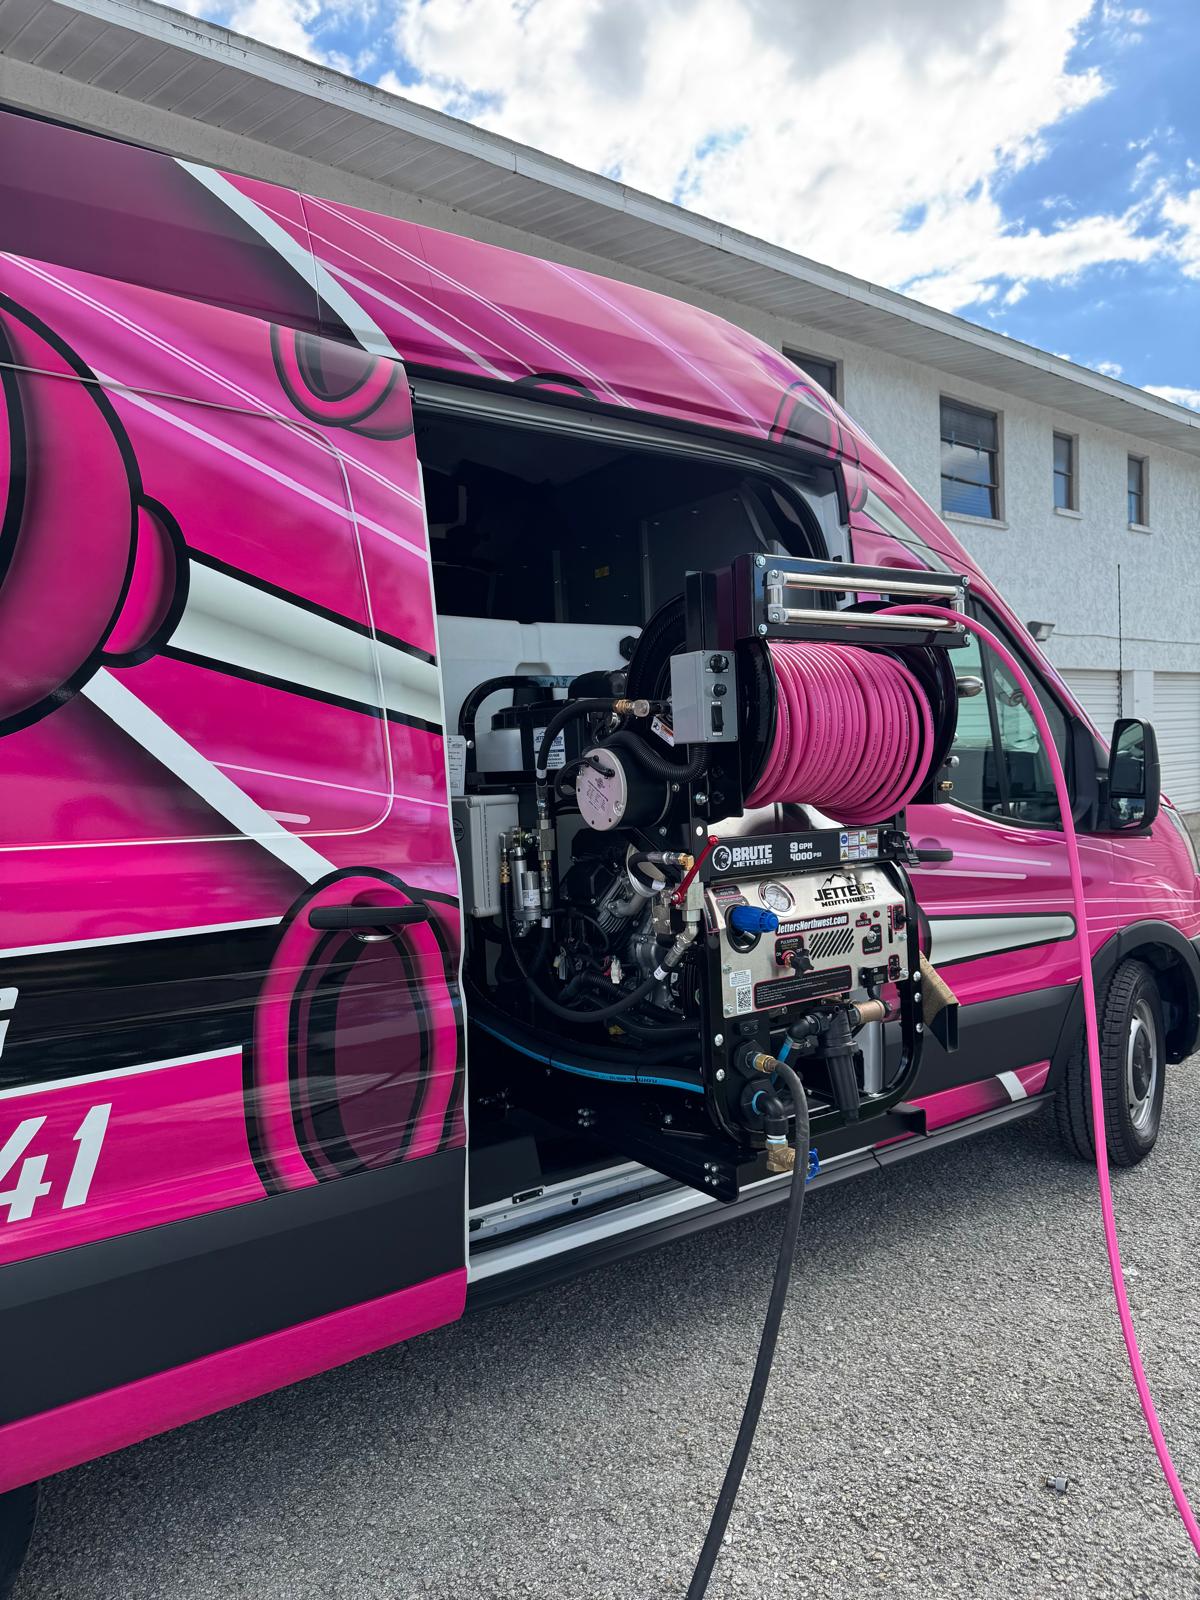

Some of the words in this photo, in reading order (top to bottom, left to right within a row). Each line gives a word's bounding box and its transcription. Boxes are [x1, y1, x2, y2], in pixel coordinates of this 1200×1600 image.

[790, 842, 798, 852] 9
[799, 842, 812, 850] GPM
[733, 845, 772, 862] BRUTE
[790, 852, 812, 861] 4000
[733, 858, 772, 867] JETTERS
[814, 883, 875, 902] JETTERS
[821, 895, 875, 907] NORTHWEST
[777, 915, 847, 934] JettersNorthwest.com
